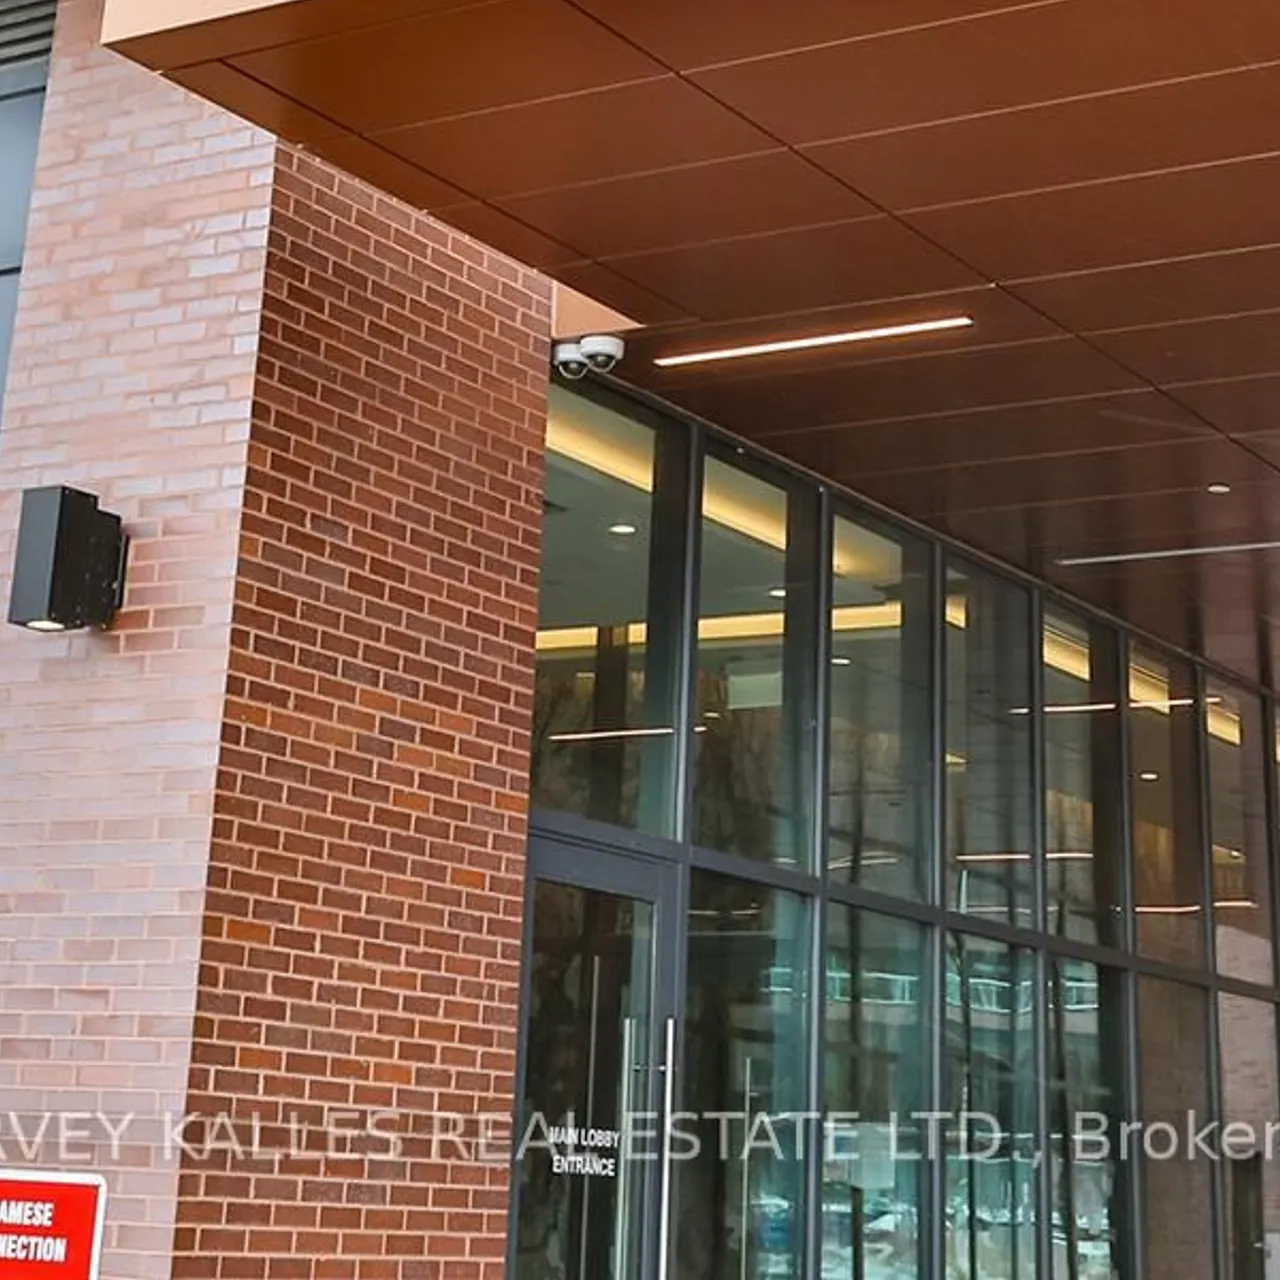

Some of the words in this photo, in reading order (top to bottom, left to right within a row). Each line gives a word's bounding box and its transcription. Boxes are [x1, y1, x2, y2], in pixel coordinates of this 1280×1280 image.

[548, 1126, 579, 1145] MAIN
[581, 1127, 620, 1148] LOBBY
[552, 1154, 616, 1177] ENTRANCE
